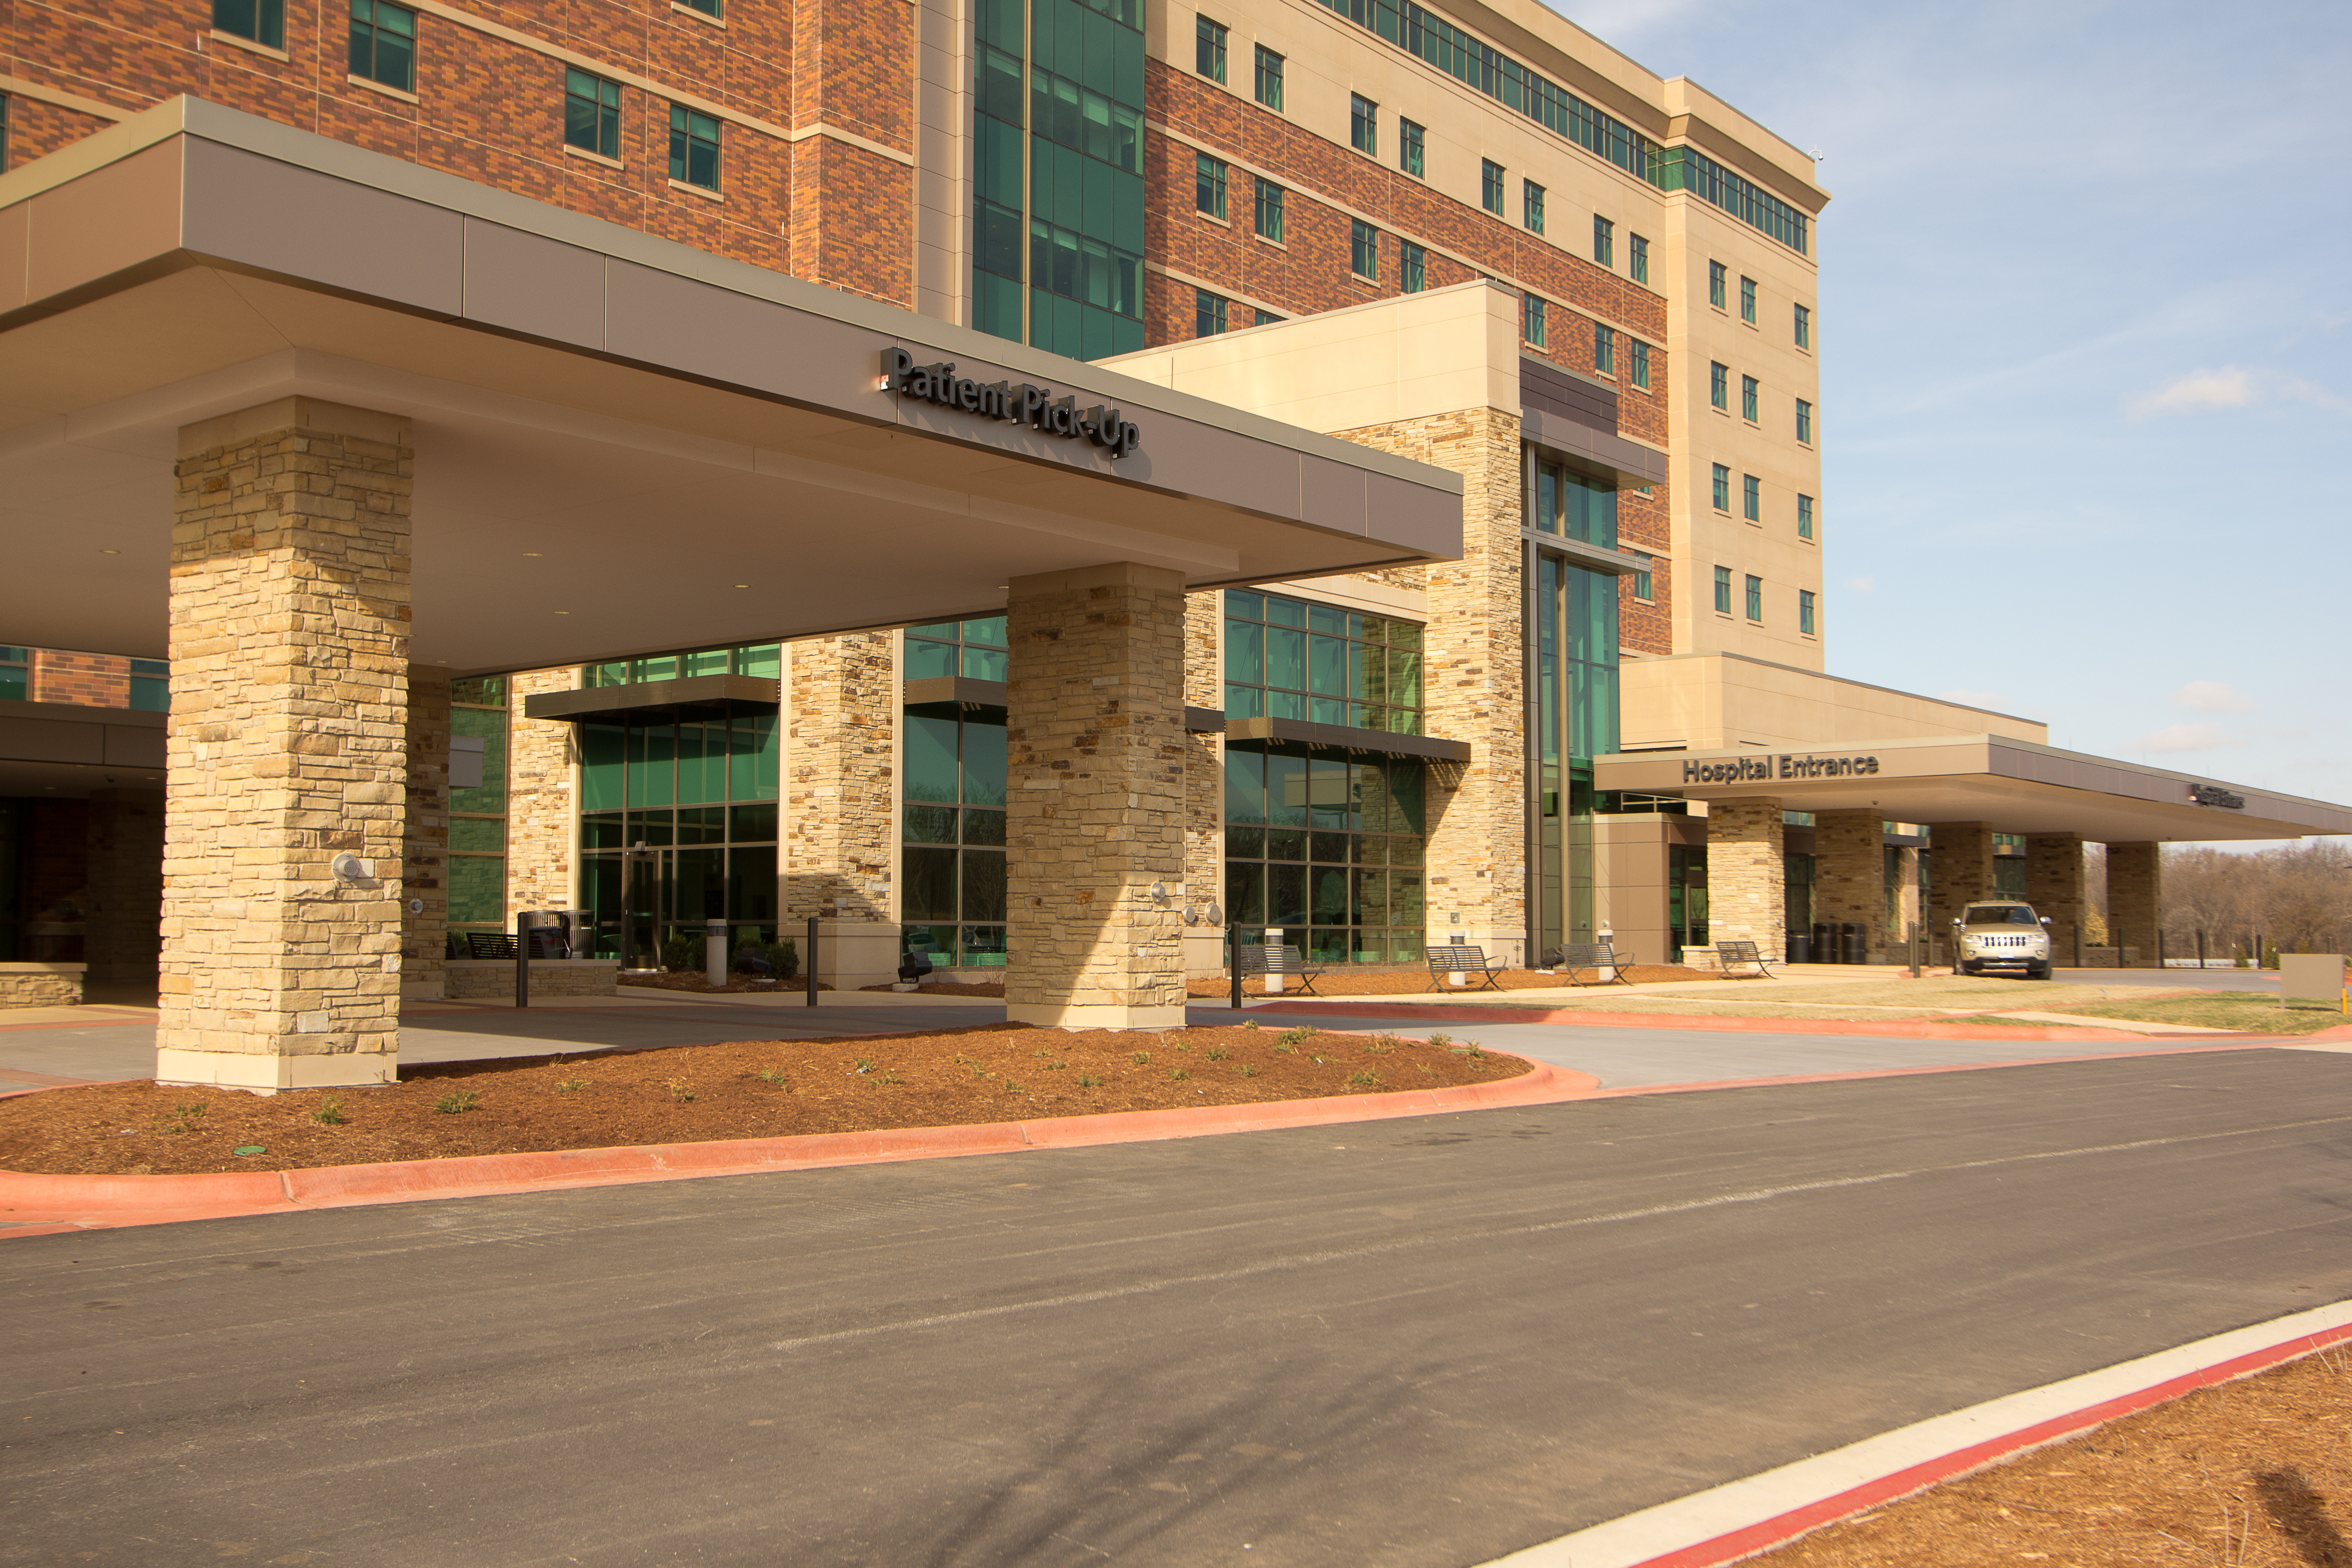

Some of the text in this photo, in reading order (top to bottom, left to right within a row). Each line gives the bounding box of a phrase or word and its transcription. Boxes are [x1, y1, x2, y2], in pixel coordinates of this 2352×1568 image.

[888, 347, 1140, 458] Patient Pick-Up
[1683, 755, 1879, 785] Hospital Entrance
